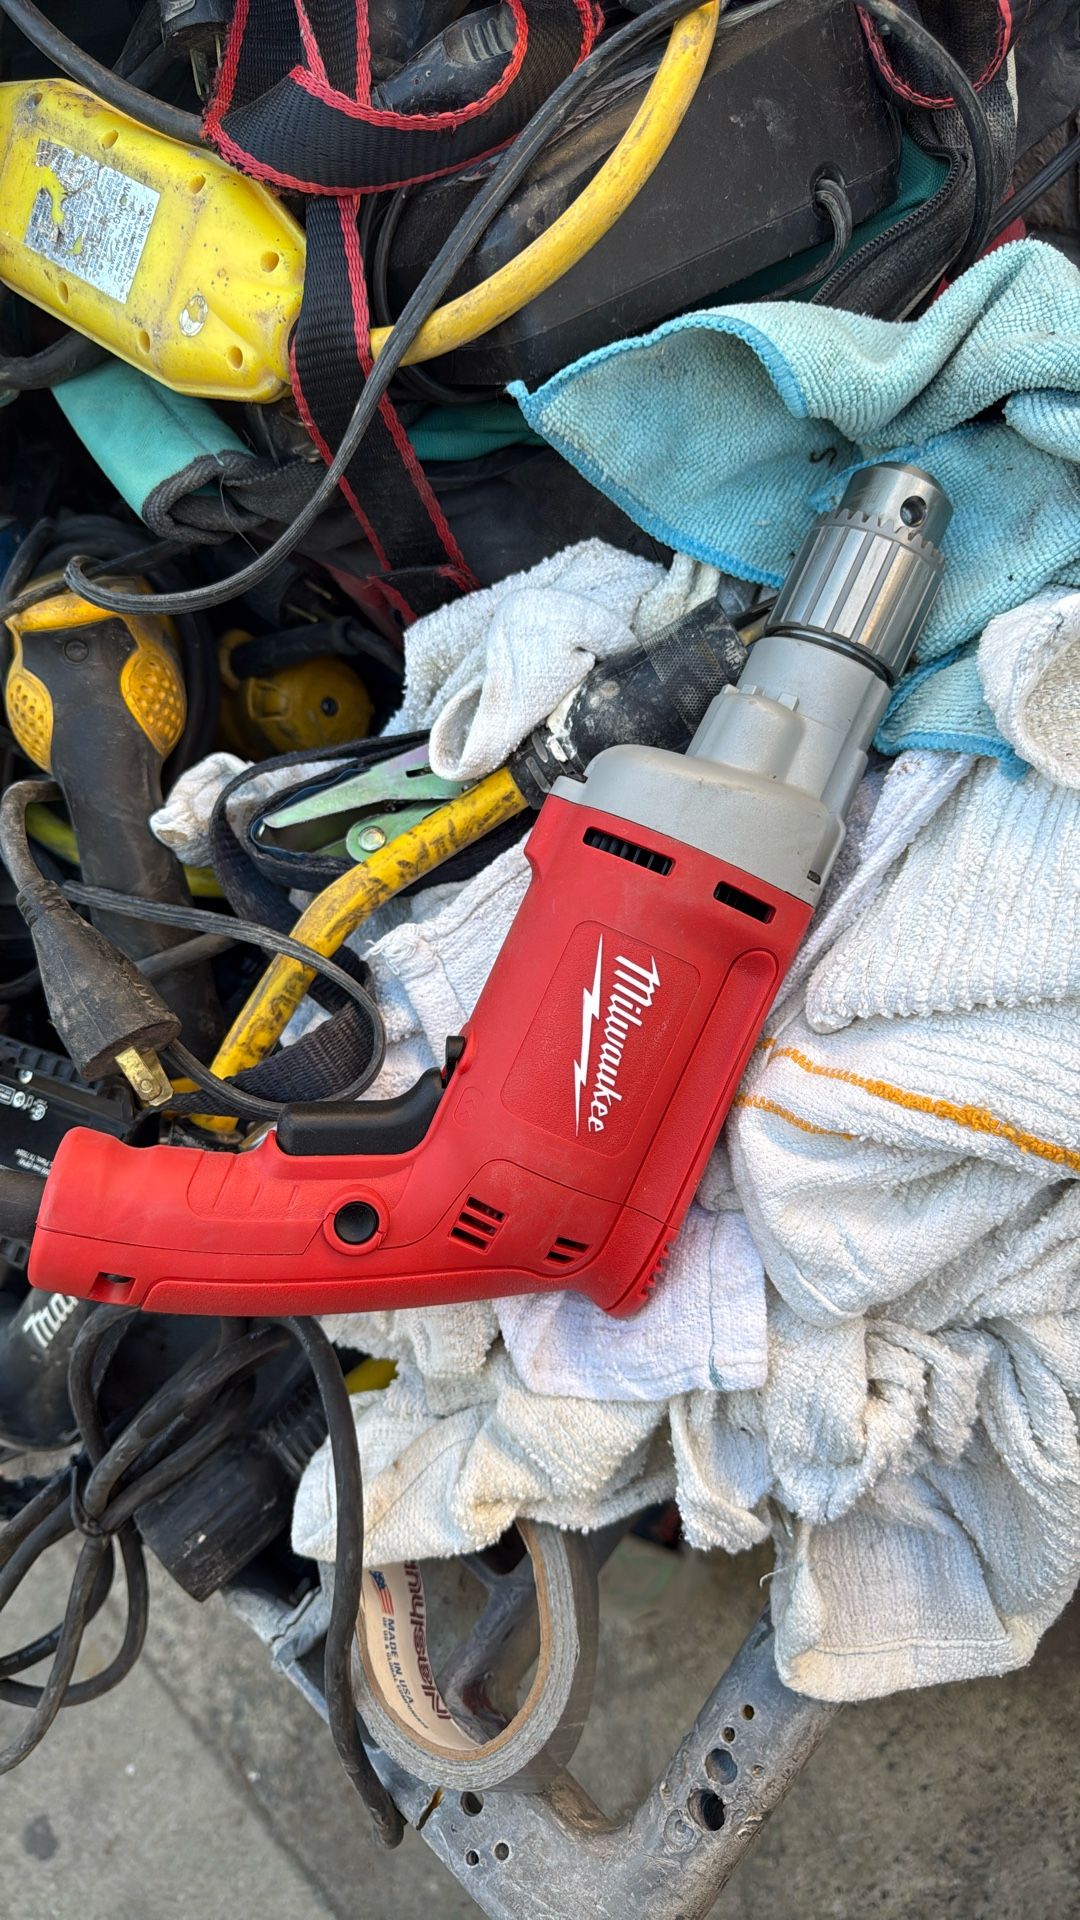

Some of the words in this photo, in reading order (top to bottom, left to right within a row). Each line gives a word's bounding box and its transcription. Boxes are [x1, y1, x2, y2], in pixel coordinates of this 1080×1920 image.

[114, 181, 133, 226] WANING
[139, 201, 155, 233] CATALOG
[588, 955, 661, 1132] Milwaukee
[387, 1618, 399, 1659] MADE
[393, 1662, 403, 1676] IN
[398, 1679, 414, 1704] USA
[404, 1560, 452, 1720] Nashu
